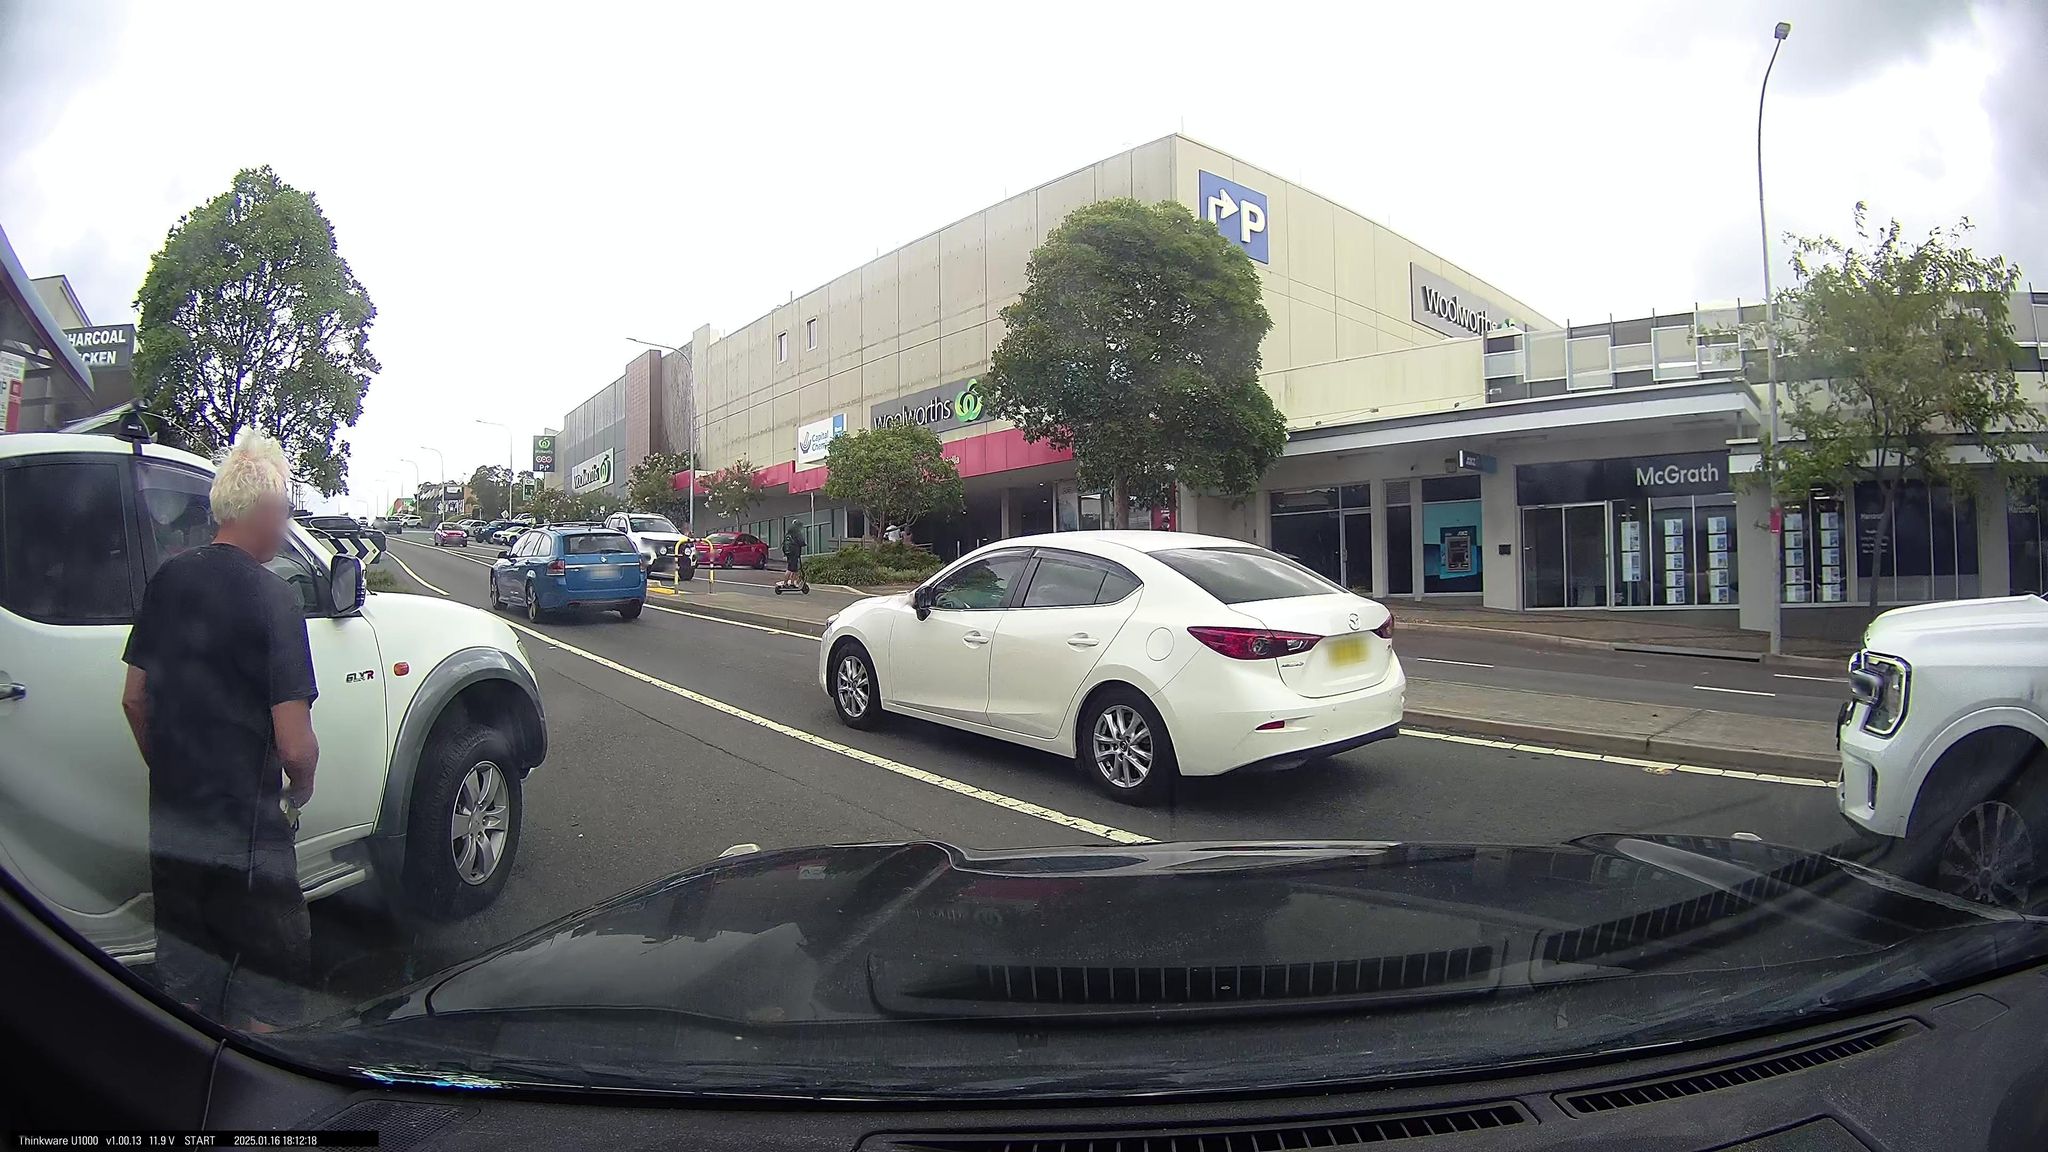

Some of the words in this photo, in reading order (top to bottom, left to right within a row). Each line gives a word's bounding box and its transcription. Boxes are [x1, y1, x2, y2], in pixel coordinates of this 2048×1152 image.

[1239, 199, 1266, 243] P
[66, 329, 126, 346] HARCOAL
[79, 350, 117, 365] CKEN
[812, 430, 829, 443] Capital
[812, 443, 827, 452] Chem
[1636, 463, 1719, 486] McGrath
